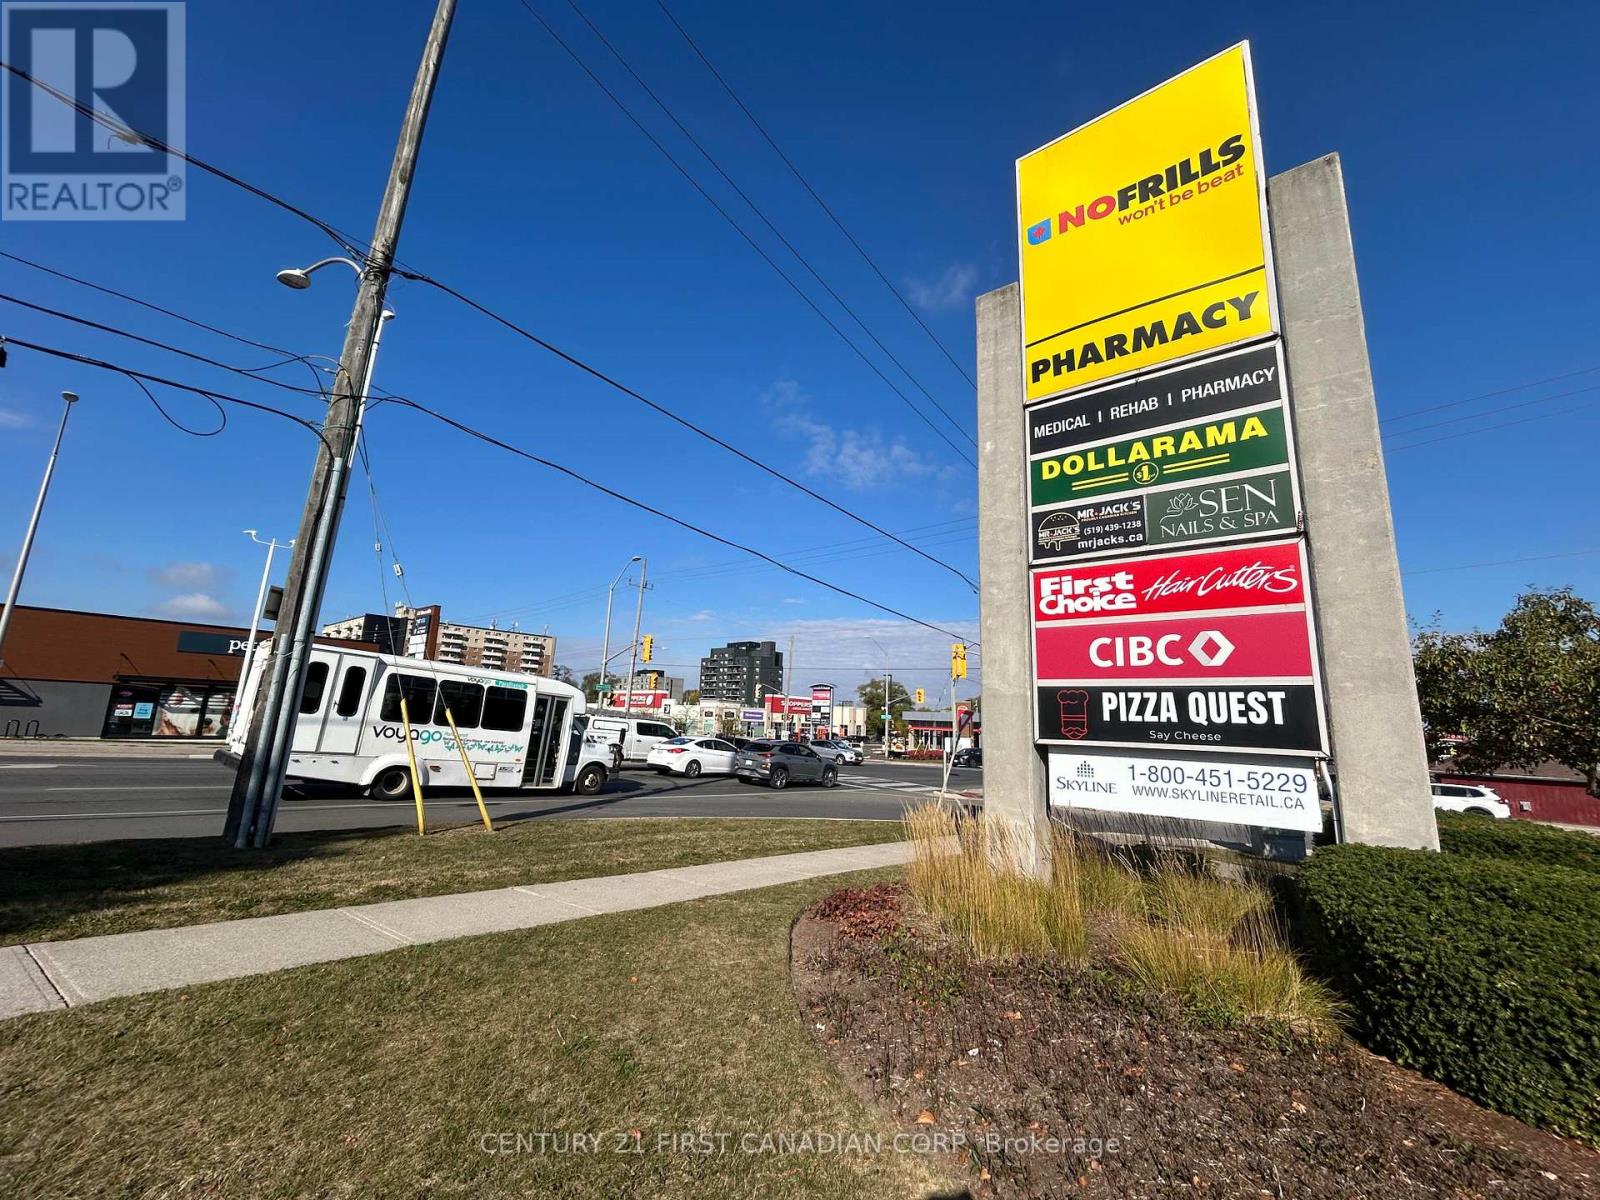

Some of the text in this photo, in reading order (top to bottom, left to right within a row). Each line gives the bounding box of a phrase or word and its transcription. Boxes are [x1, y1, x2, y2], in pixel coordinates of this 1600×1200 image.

[1118, 162, 1245, 227] won't be beat
[1031, 290, 1260, 384] PHARMACY
[1034, 413, 1091, 439] MEDICAL
[1110, 397, 1159, 420] REHAB
[1181, 366, 1276, 402] PHARMACY
[1041, 415, 1269, 481] DOLLARAMA
[1198, 478, 1279, 519] SEN
[1083, 520, 1142, 536] (519) 439-1238
[1160, 509, 1280, 538] NAILS & SPA
[1077, 533, 1143, 549] mrjacks.ca
[1039, 570, 1134, 597] First
[1038, 590, 1137, 616] Choice
[1088, 633, 1185, 668] CIBC
[1101, 690, 1286, 727] PIZZA QUEST
[1149, 729, 1222, 742] Say Cheese
[1056, 775, 1118, 795] SKYLINE
[1127, 763, 1308, 794] 1-800-451-5229
[1131, 784, 1305, 811] WWW.SKYLINERETAIL.CA
